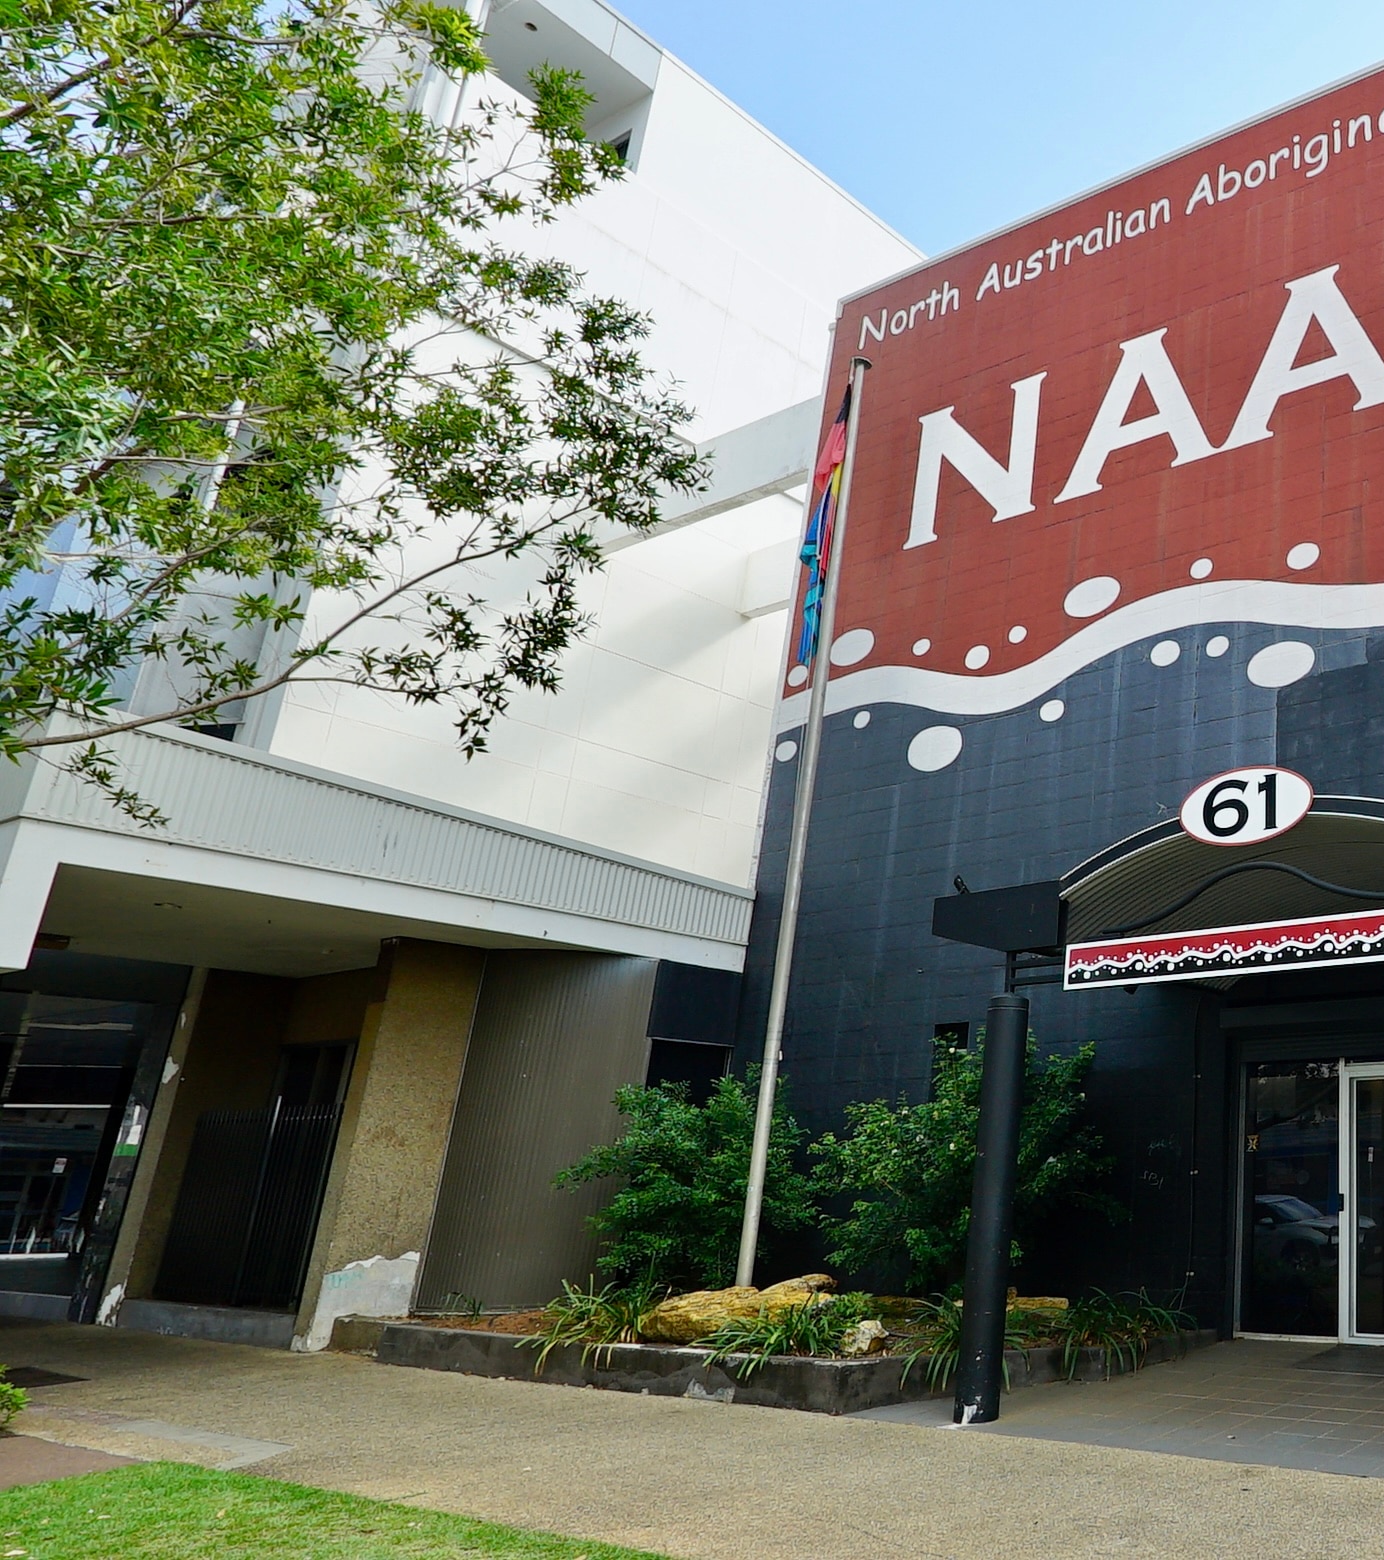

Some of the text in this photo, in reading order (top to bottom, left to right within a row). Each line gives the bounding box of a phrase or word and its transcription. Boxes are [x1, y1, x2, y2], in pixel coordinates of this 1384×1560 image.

[857, 281, 961, 350] North
[976, 198, 1171, 302] Australian
[1202, 772, 1279, 837] 61
